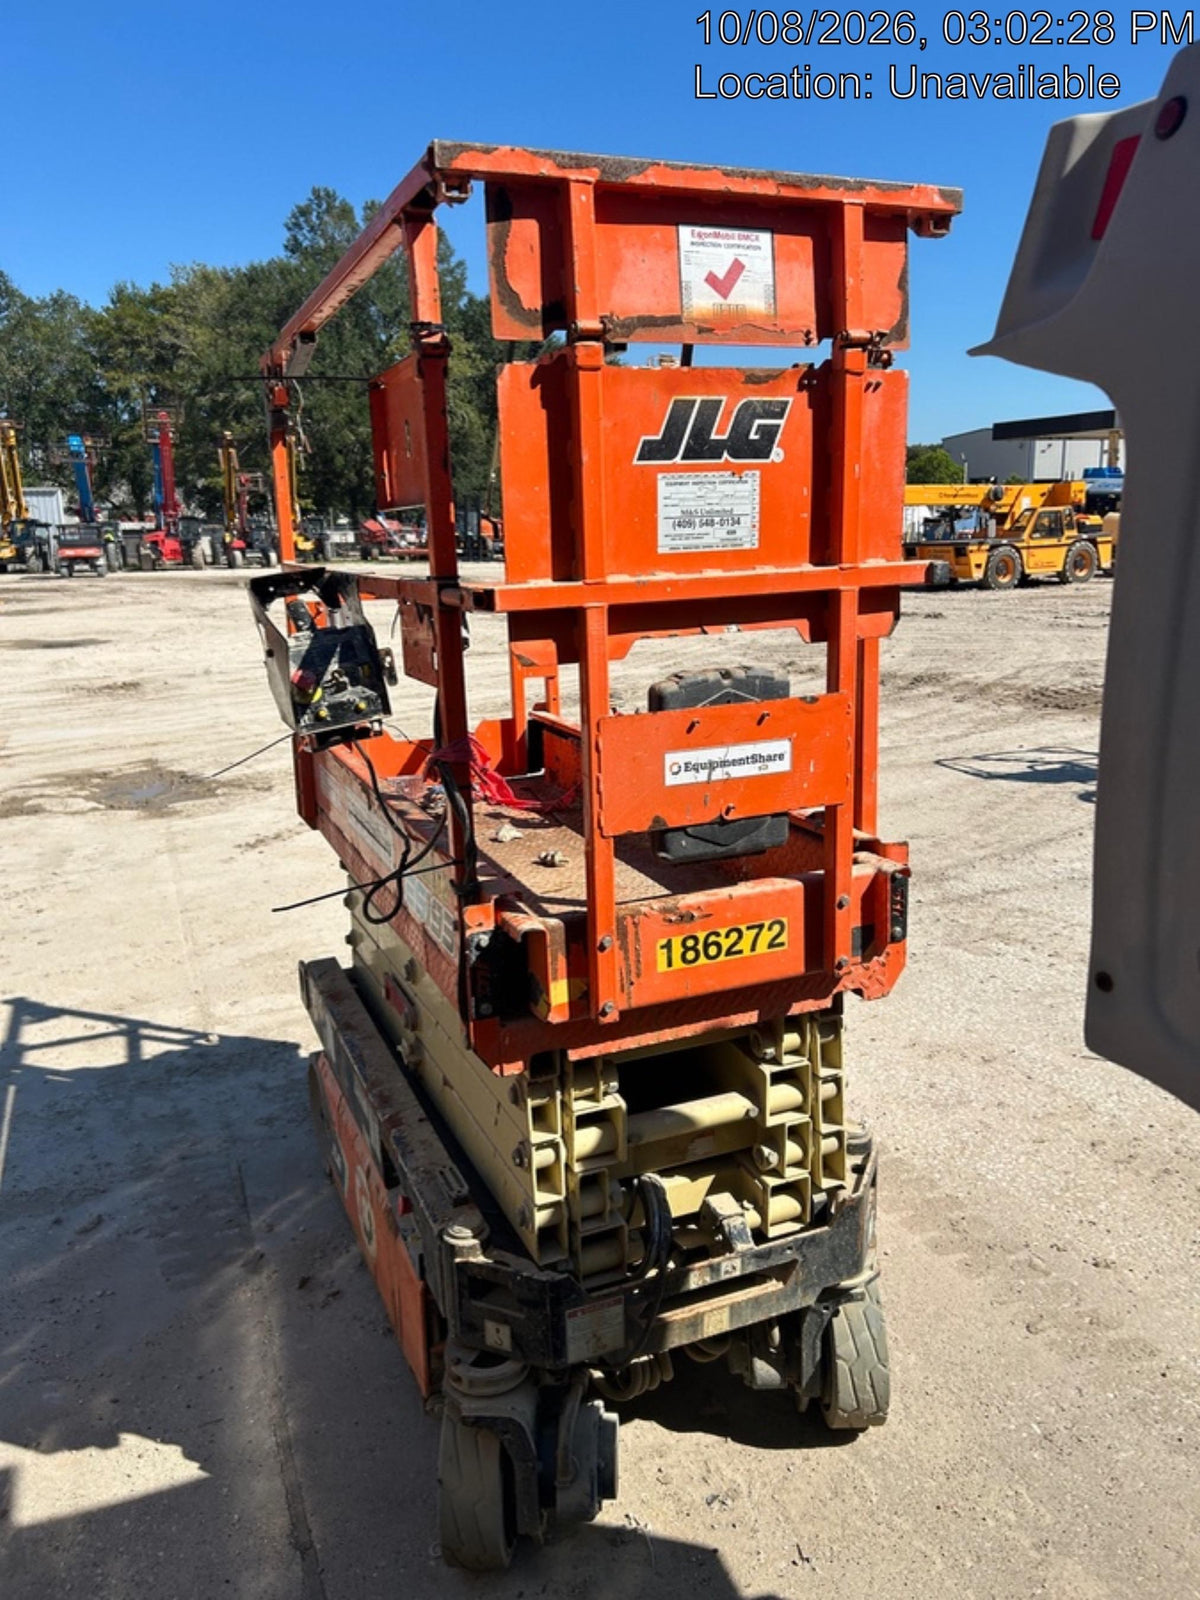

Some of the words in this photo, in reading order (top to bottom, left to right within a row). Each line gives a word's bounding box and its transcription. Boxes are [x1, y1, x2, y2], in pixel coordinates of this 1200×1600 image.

[632, 396, 794, 465] JLG
[672, 518, 697, 531] (409)
[683, 752, 785, 774] EquipmentShare
[659, 918, 786, 968] 186272
